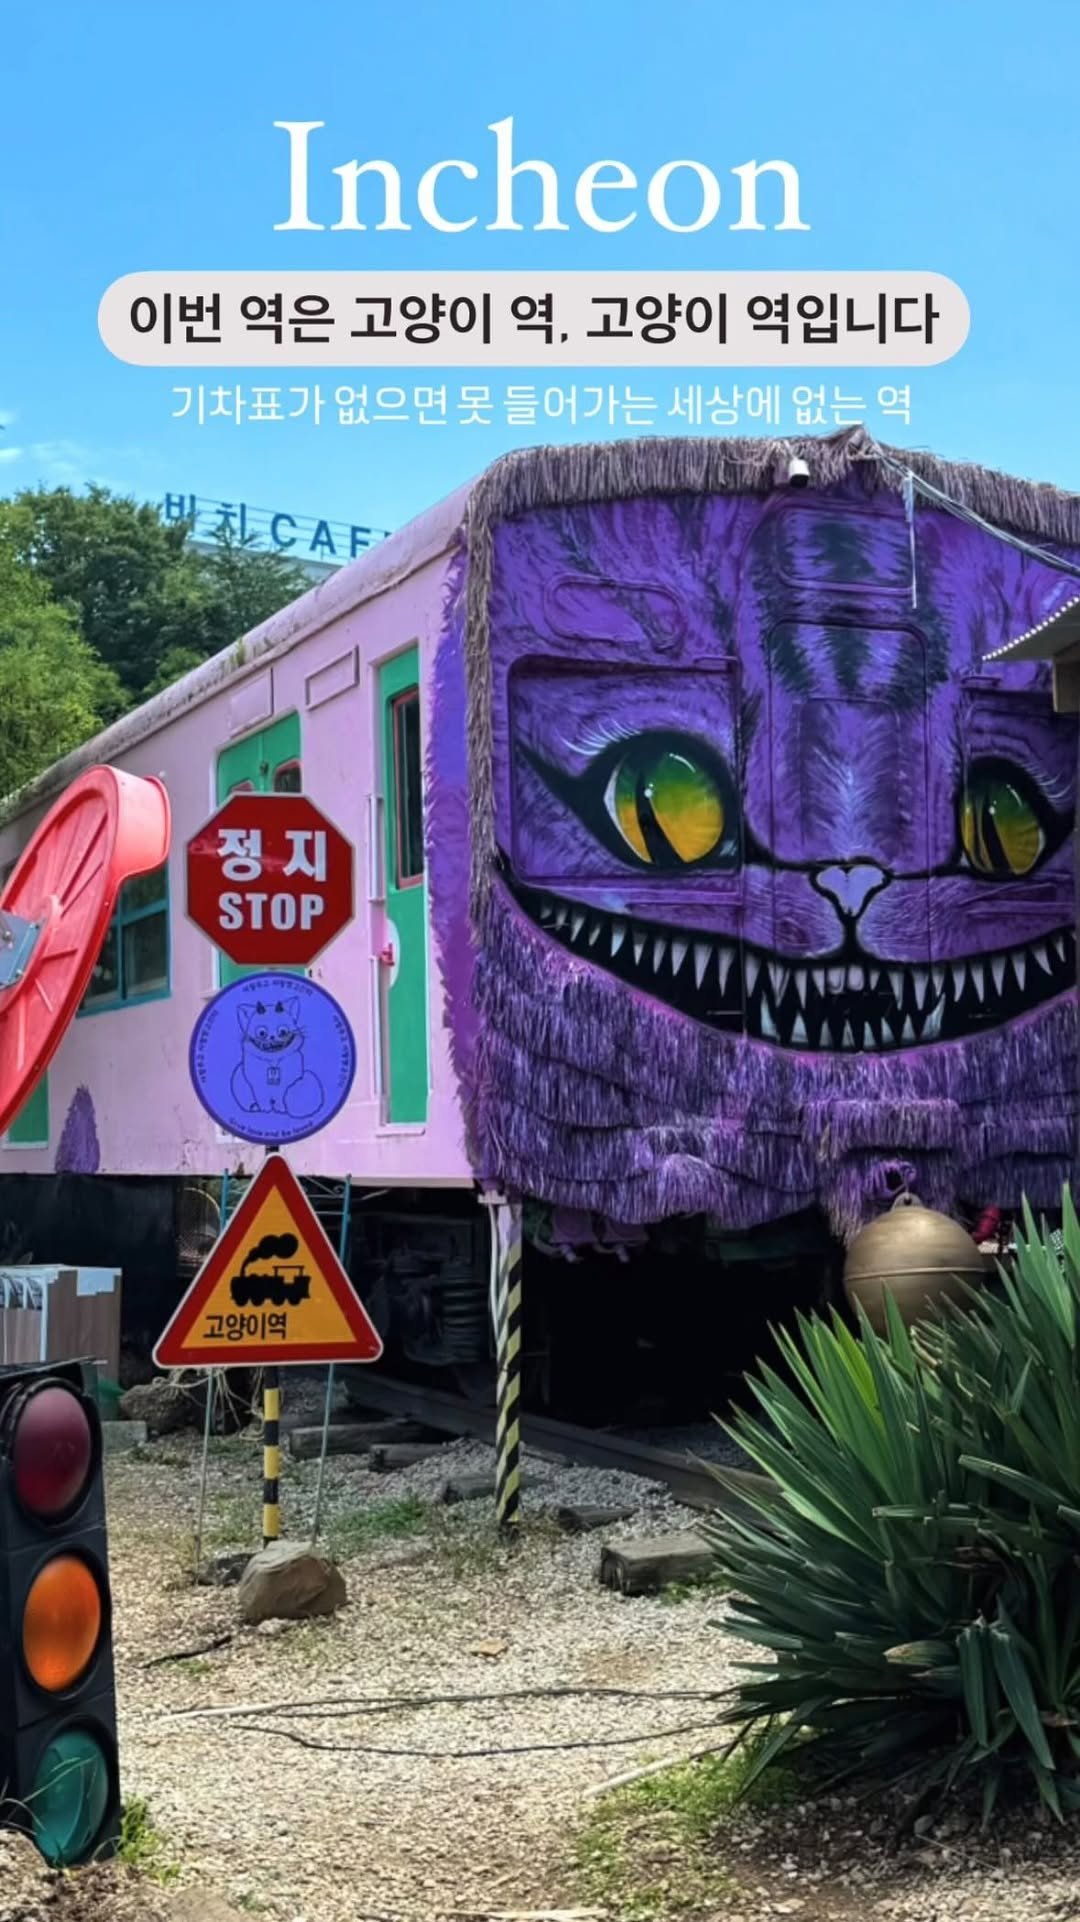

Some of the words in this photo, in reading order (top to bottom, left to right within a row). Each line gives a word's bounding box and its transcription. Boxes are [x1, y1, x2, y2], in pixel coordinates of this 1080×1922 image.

[271, 513, 391, 558] CAF
[218, 892, 325, 932] STOP
[203, 1312, 287, 1341] 고양이역
